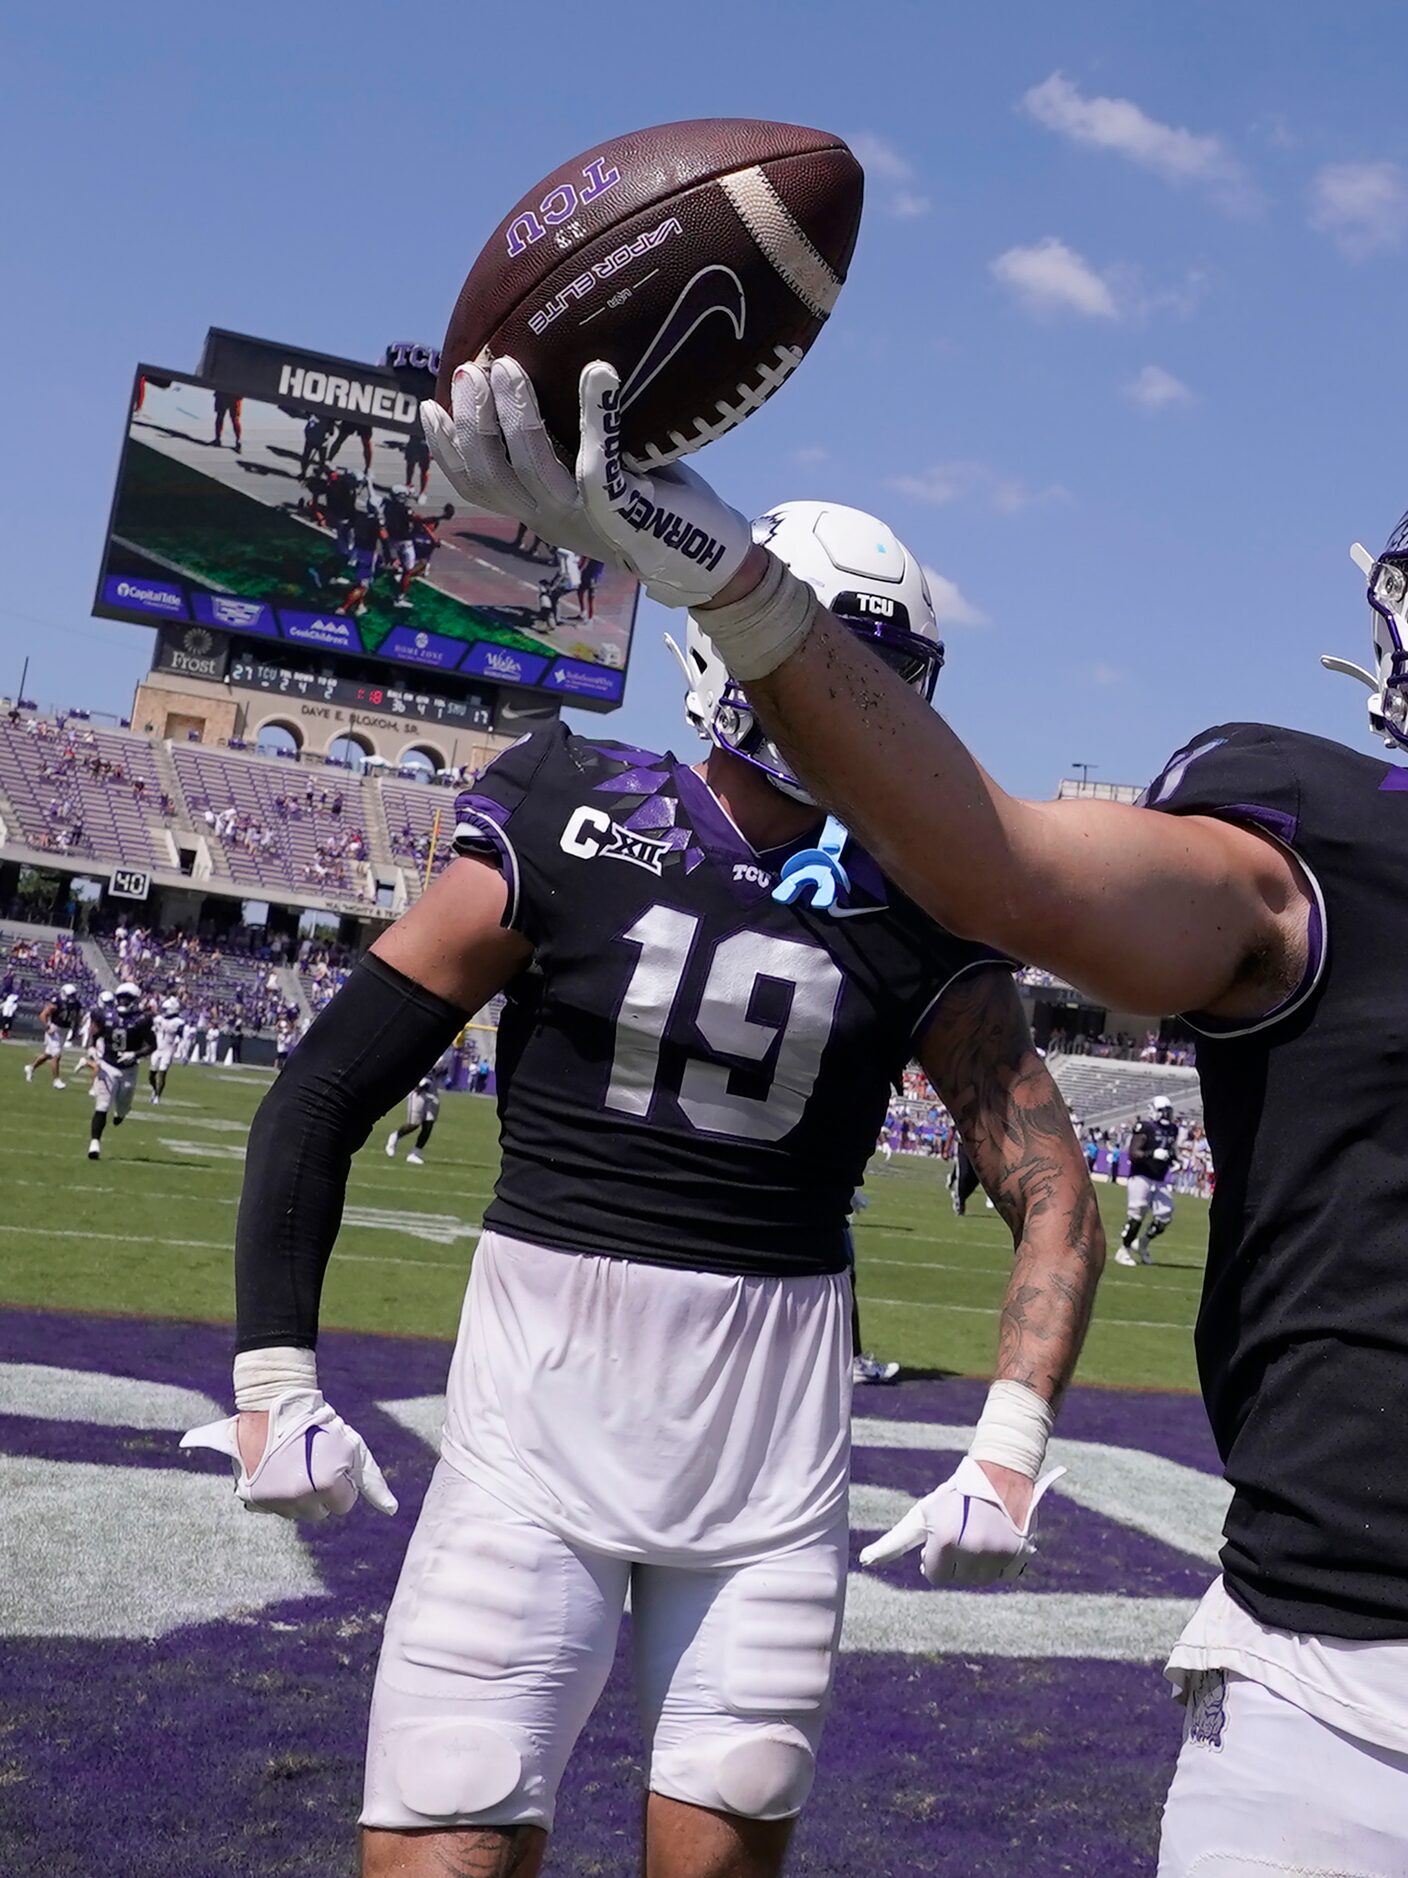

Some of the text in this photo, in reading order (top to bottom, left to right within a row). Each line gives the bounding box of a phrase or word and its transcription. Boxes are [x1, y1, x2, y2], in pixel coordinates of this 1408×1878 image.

[505, 156, 621, 258] TCU
[591, 217, 683, 279] VAPOR
[527, 271, 596, 336] ELITE
[391, 341, 441, 375] TCU
[278, 364, 418, 424] HORNED
[856, 593, 894, 617] TCU
[170, 650, 216, 675] Frost
[232, 664, 278, 680] 27 TCU
[301, 704, 331, 719] DAVE
[474, 710, 488, 724] 17
[560, 805, 611, 860] C
[117, 872, 145, 895] 40
[732, 863, 771, 889] TCU
[604, 904, 843, 1142] 19
[111, 1028, 127, 1052] 9
